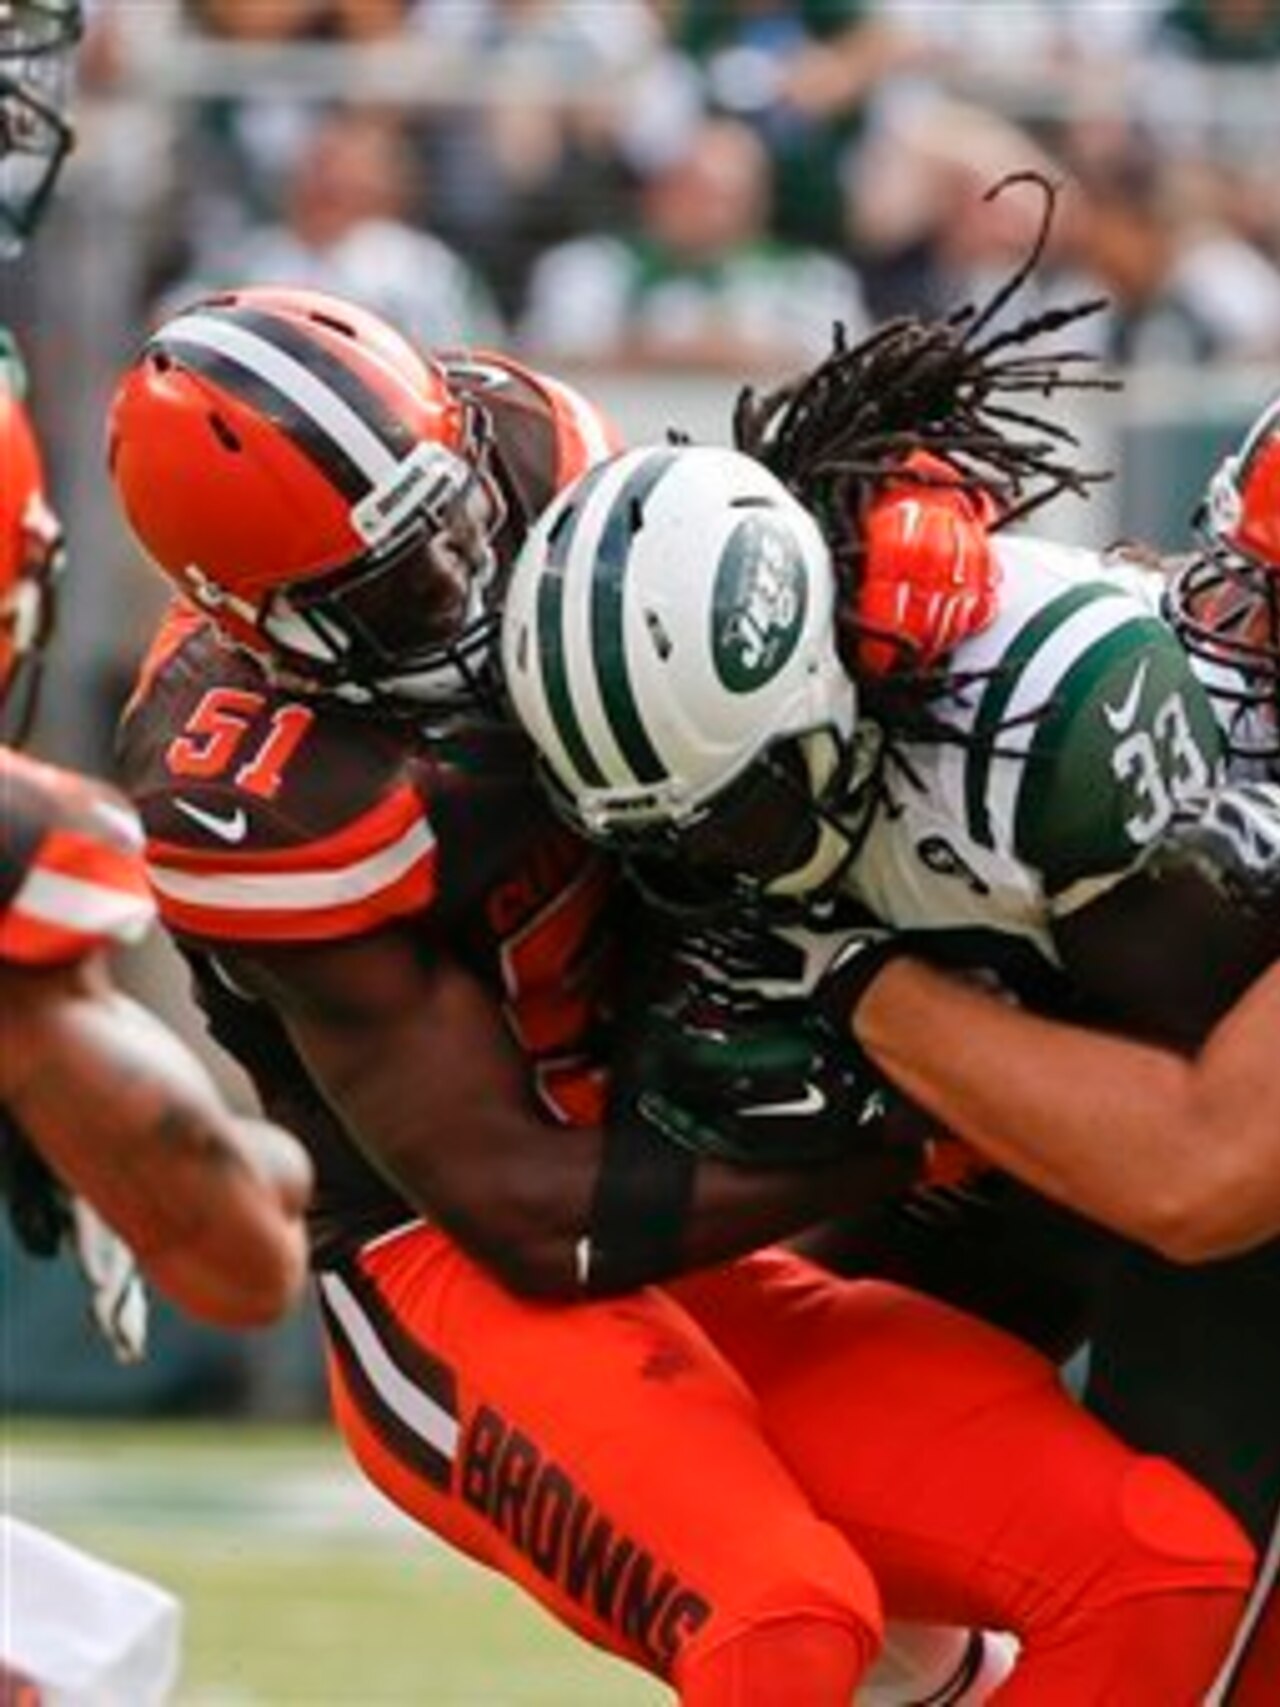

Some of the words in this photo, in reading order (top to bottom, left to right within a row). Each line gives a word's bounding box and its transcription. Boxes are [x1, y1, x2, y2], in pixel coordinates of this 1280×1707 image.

[166, 687, 314, 799] 51
[1112, 691, 1208, 844] 33
[461, 1403, 713, 1680] BROWNS
